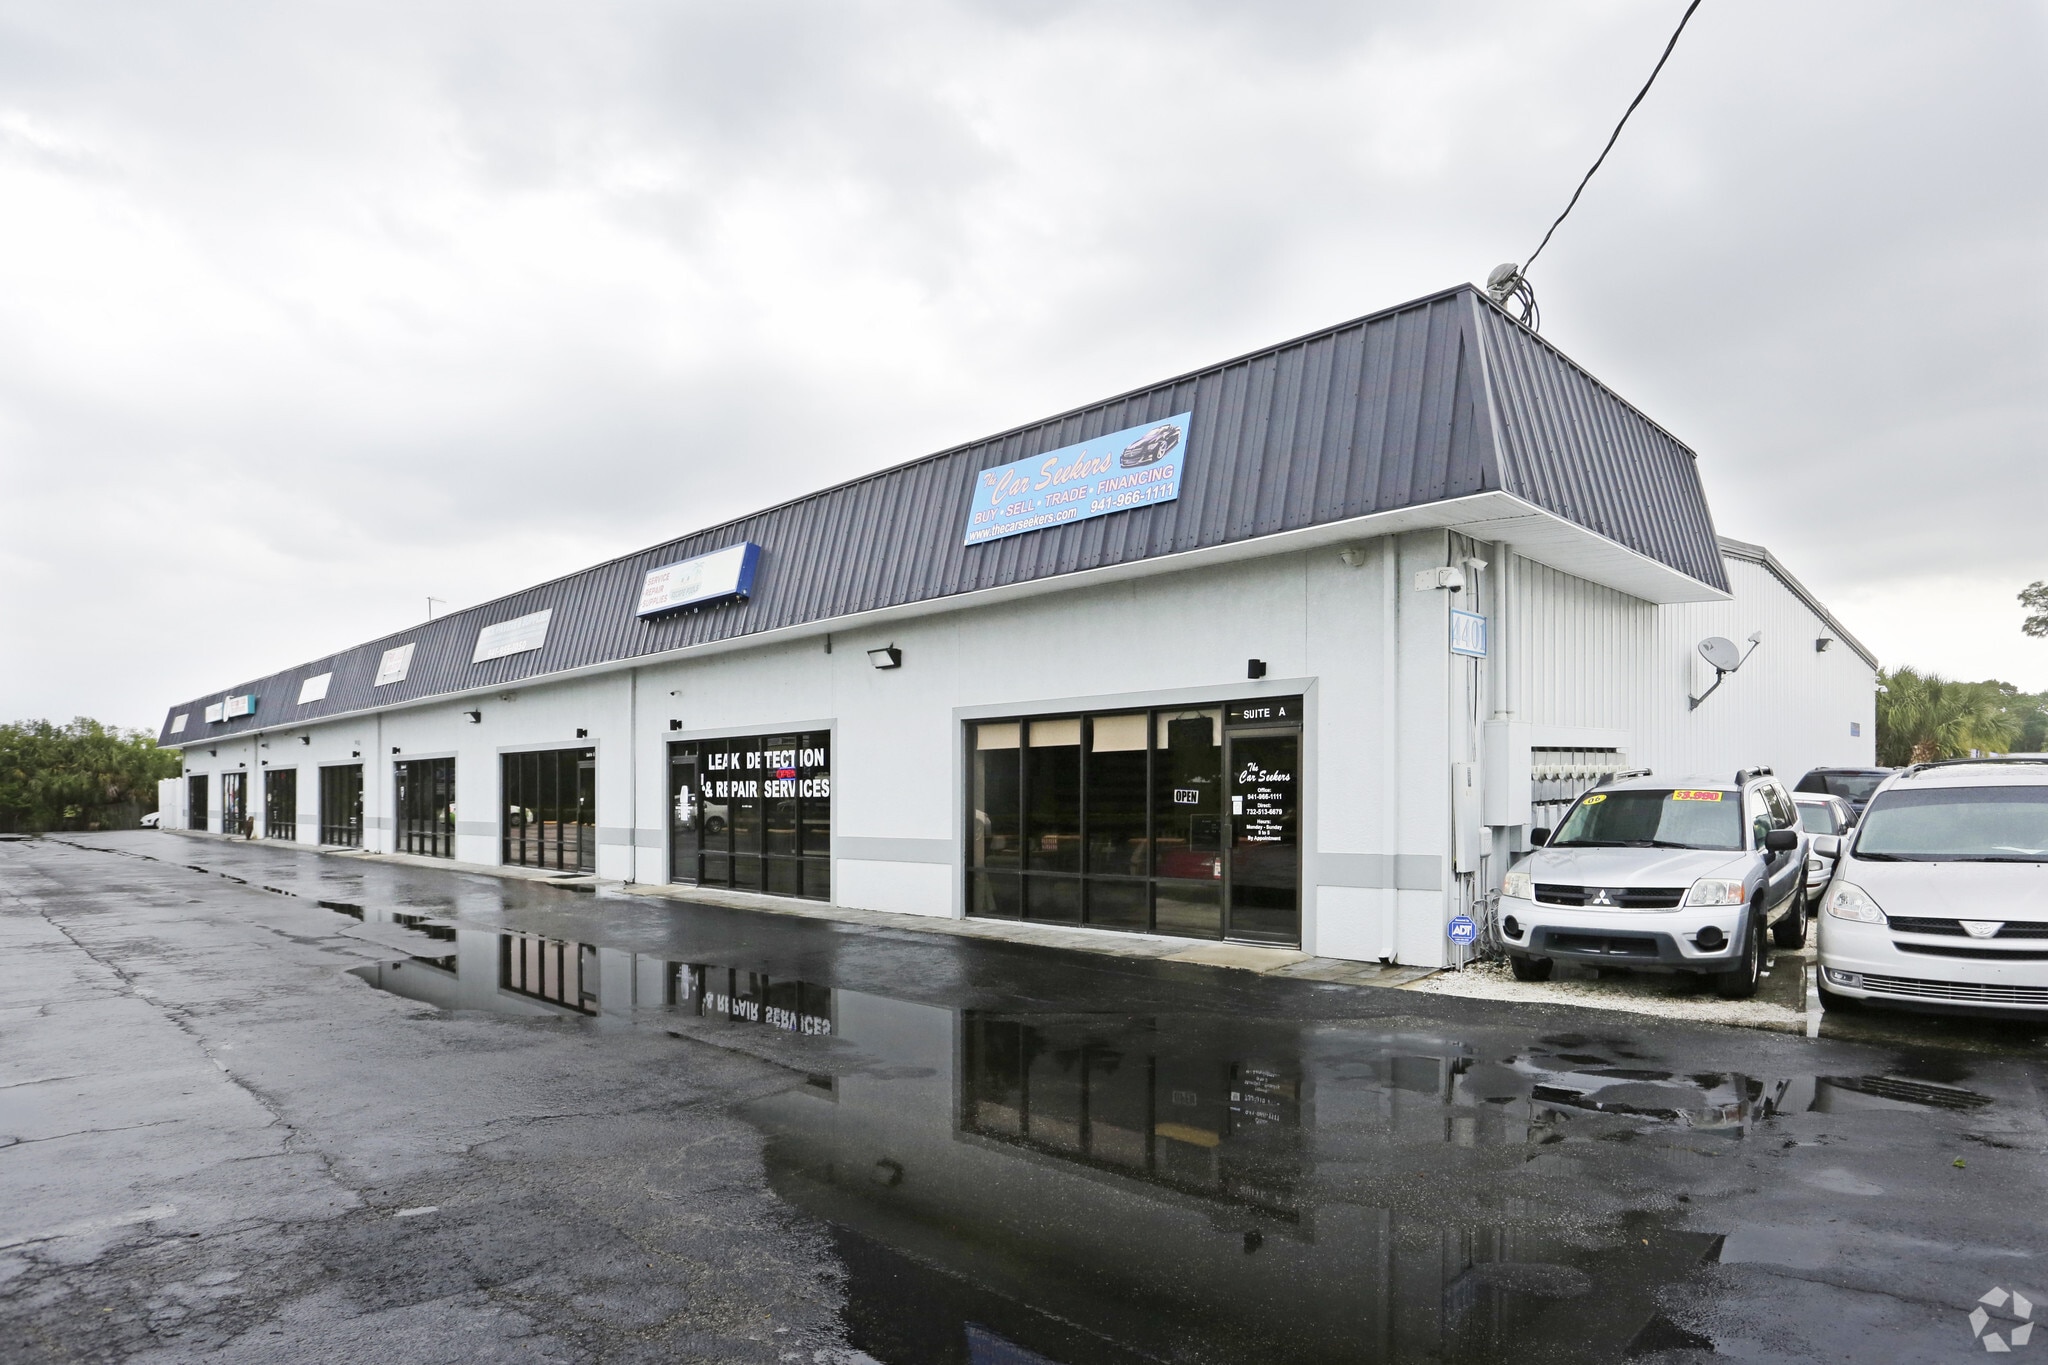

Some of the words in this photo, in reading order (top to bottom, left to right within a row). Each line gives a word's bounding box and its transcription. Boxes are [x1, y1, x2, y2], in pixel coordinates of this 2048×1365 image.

[984, 472, 997, 488] The
[991, 468, 1030, 506] Car
[1034, 449, 1112, 491] Seekers
[974, 507, 998, 525] BUY
[1006, 499, 1035, 517] SELL
[1045, 485, 1088, 507] TRADE
[1097, 464, 1174, 495] FINANCING
[969, 508, 1077, 541] www.thecarseekers.com
[1090, 482, 1174, 513] 941-966-1111
[1243, 708, 1270, 719] SUITE
[1278, 707, 1286, 717] A
[708, 752, 740, 770] LEAK
[747, 748, 824, 769] DETECTION
[1247, 762, 1259, 772] The
[1239, 770, 1256, 784] Car
[1258, 769, 1291, 782] Seekers
[705, 781, 713, 798] &
[716, 780, 758, 798] REPAIR
[764, 779, 830, 798] SERVICES
[1176, 791, 1197, 802] OPEN
[1453, 925, 1472, 936] ADT
